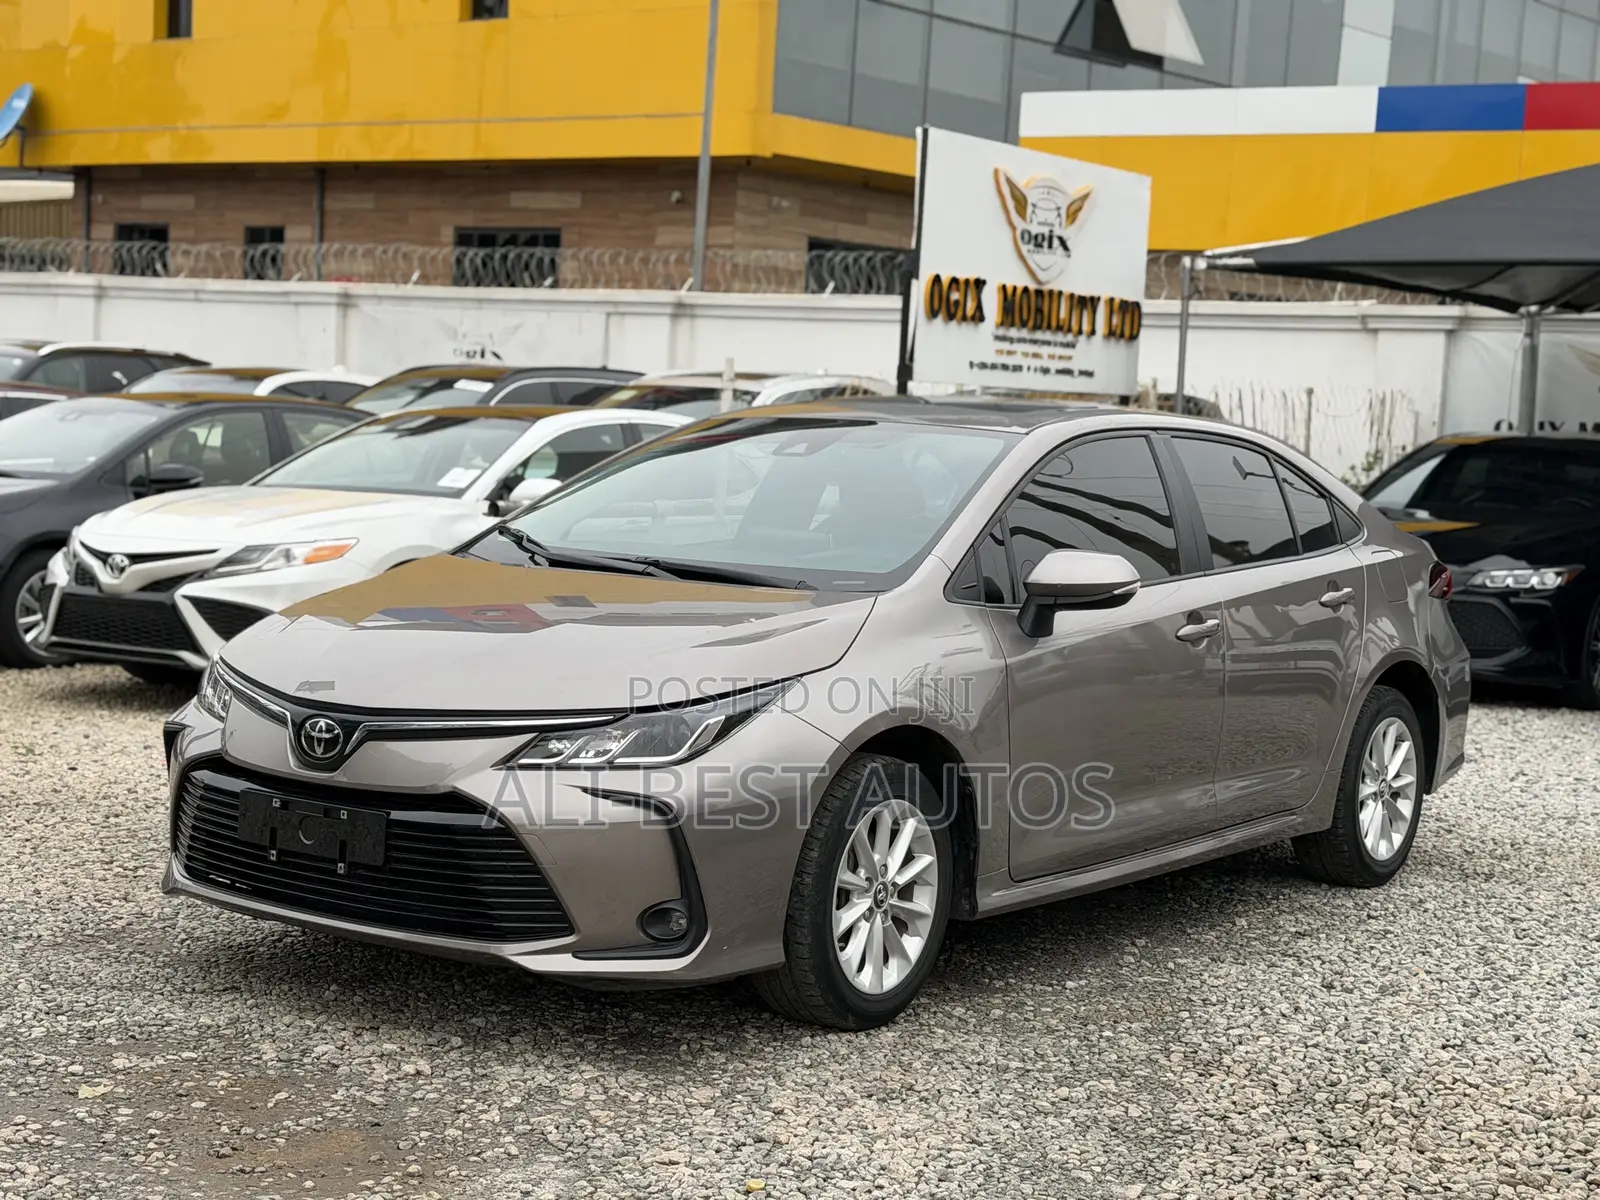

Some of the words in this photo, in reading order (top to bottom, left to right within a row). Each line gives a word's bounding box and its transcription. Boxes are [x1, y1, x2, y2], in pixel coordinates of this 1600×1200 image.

[925, 273, 987, 324] OGIX
[996, 283, 1101, 337] MOBILITY
[1103, 296, 1142, 341] LTD
